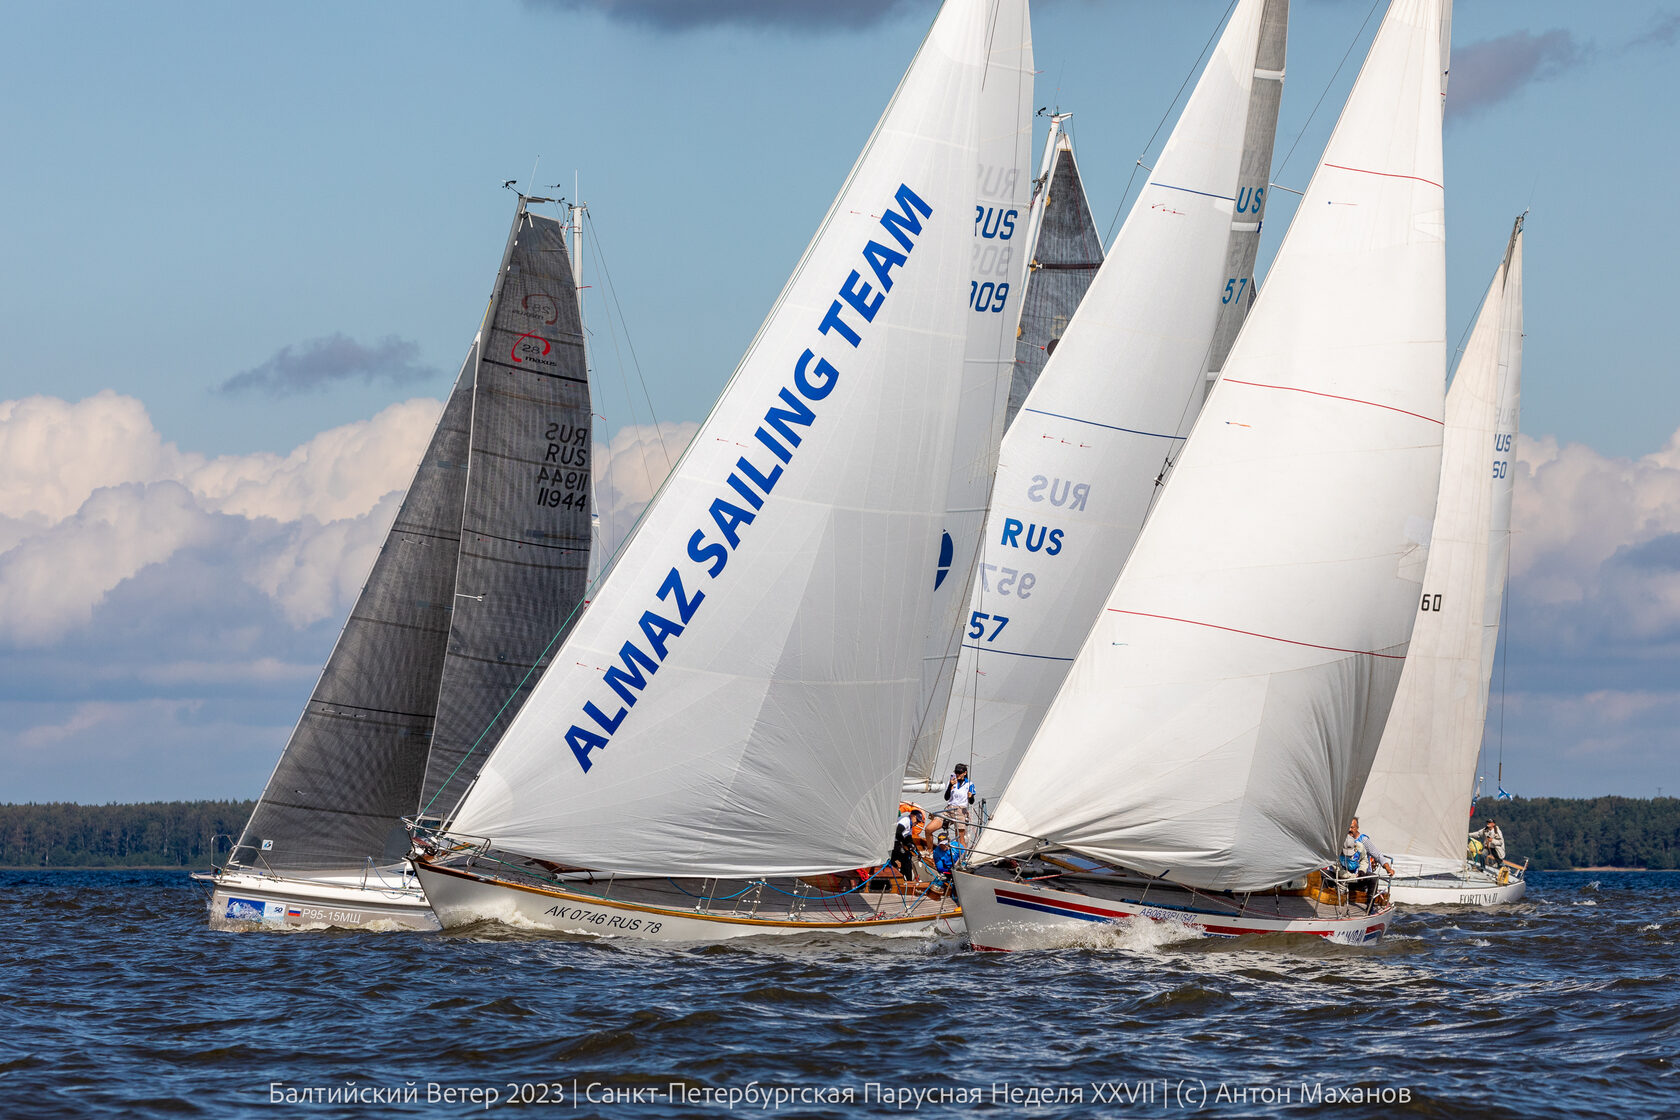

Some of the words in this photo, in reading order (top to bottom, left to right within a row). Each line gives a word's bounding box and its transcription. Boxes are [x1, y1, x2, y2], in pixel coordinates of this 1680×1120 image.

[1236, 186, 1264, 214] US
[1222, 278, 1248, 305] 57
[522, 343, 541, 354] 28
[545, 442, 587, 467] RUS
[1494, 433, 1512, 452] US
[564, 566, 706, 773] ALMAZ
[687, 347, 840, 579] SAILING
[818, 182, 934, 349] TEAM
[537, 487, 587, 512] 11944
[1000, 517, 1065, 556] RUS
[1421, 593, 1442, 612] 60
[968, 610, 1010, 643] 57
[569, 909, 608, 925] 0746
[606, 915, 642, 931] RUS
[642, 921, 663, 934] 78
